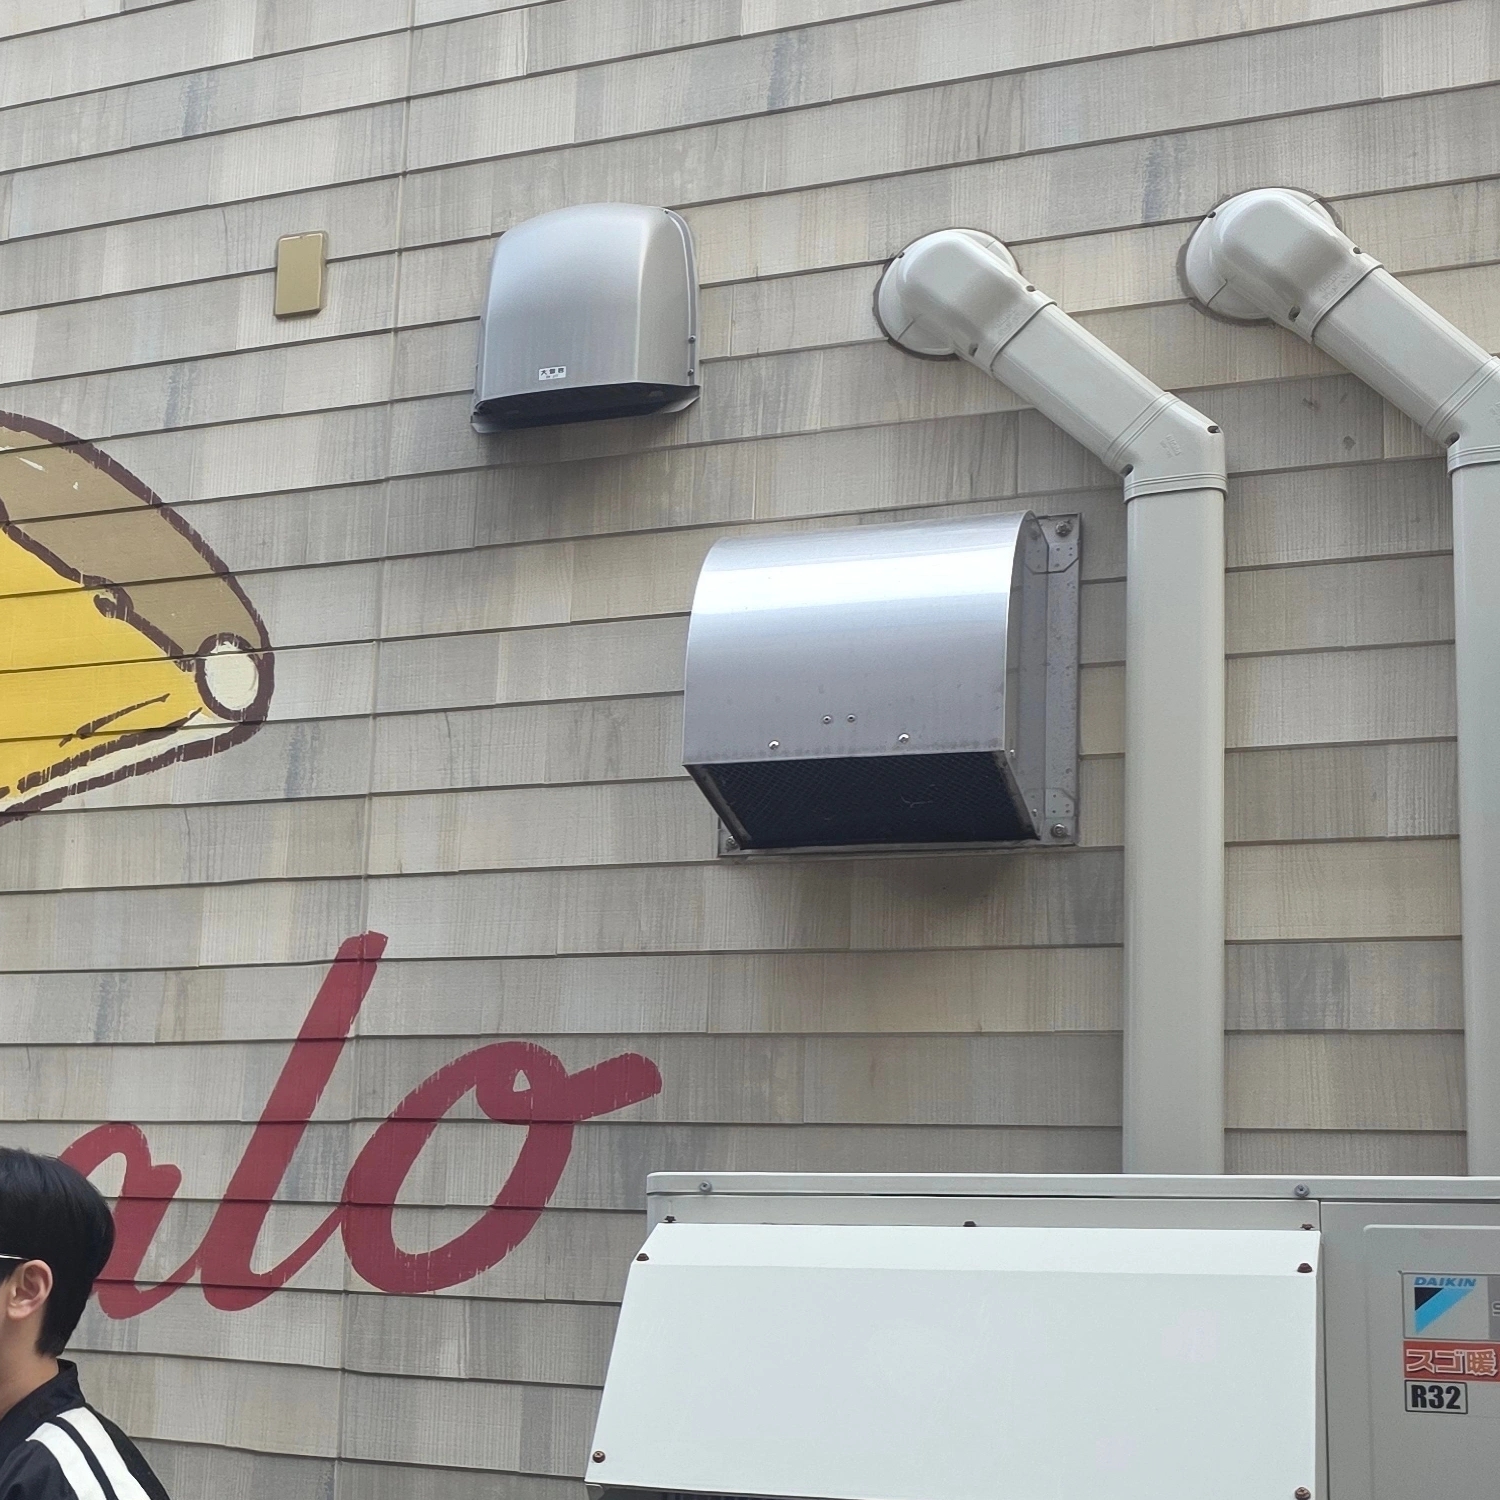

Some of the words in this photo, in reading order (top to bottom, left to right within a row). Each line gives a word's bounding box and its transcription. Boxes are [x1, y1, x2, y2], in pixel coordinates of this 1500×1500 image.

[1413, 1276, 1477, 1288] DAIKIN
[1405, 1348, 1499, 1377] スゴ暖
[1410, 1384, 1462, 1410] R32
